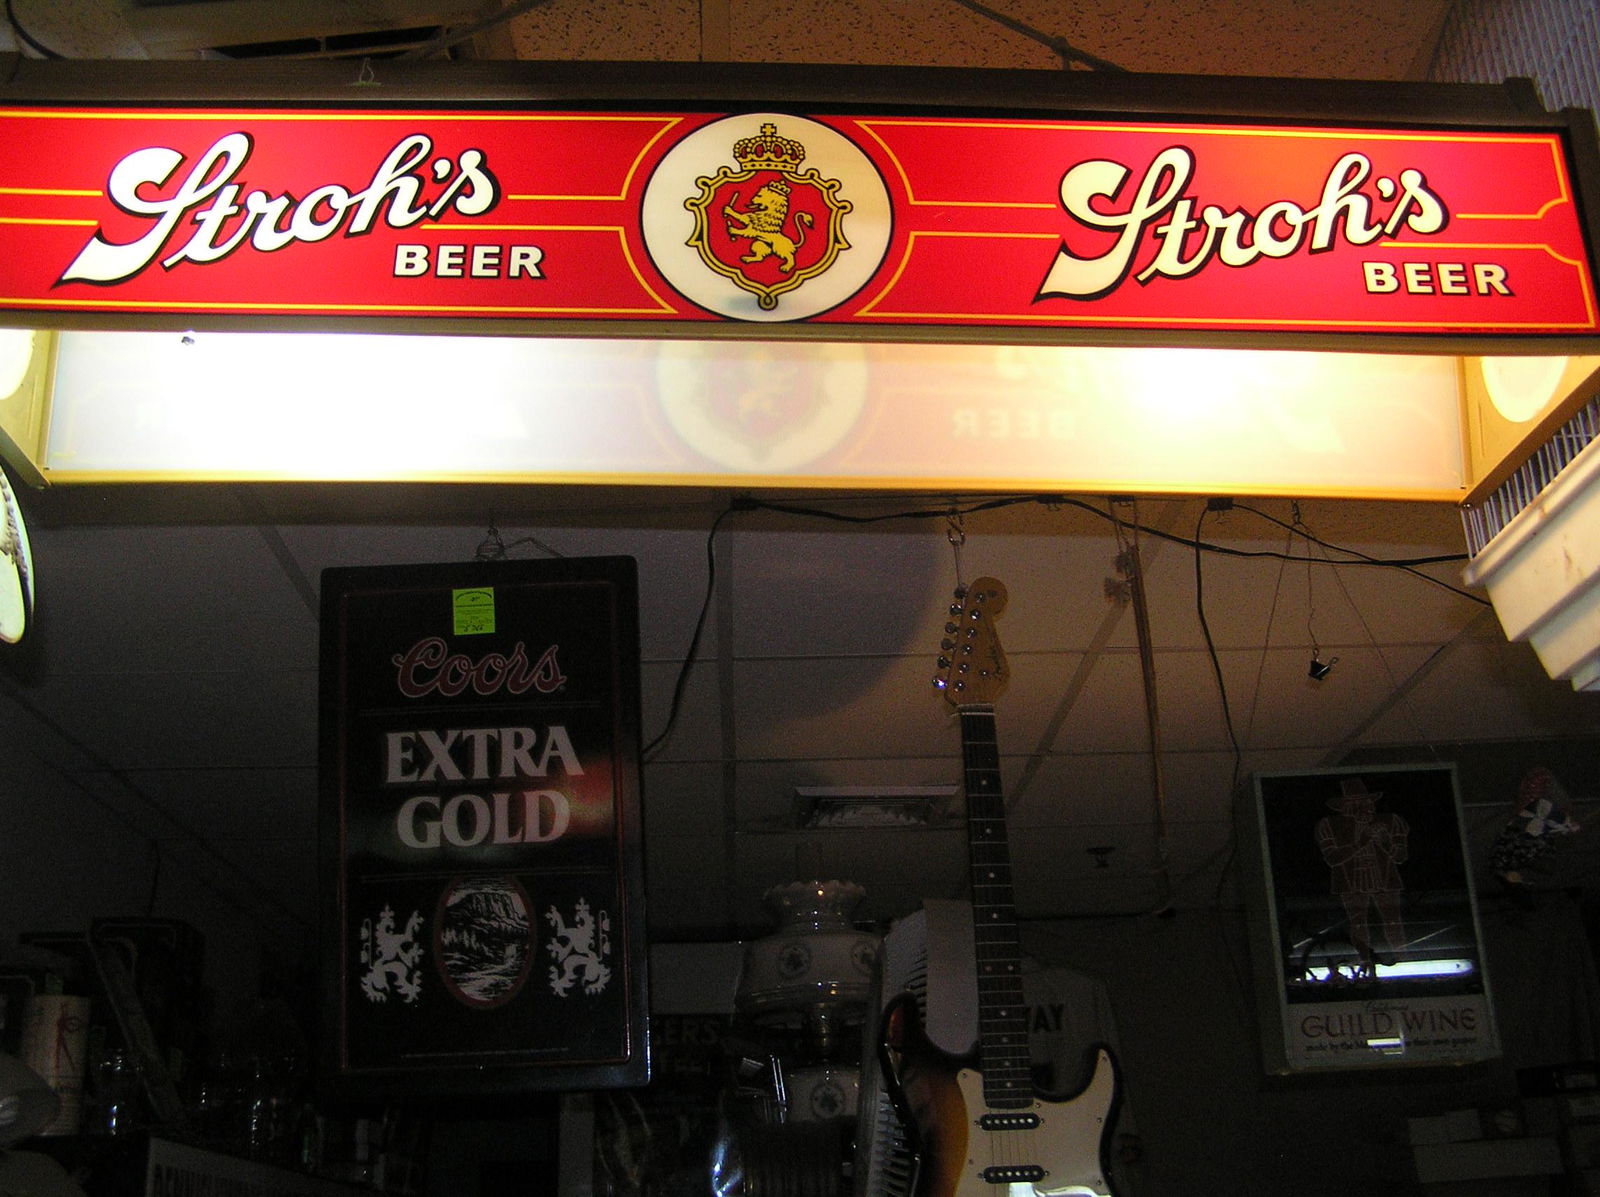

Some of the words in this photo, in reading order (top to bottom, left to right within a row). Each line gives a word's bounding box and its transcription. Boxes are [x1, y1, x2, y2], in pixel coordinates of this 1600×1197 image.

[56, 132, 500, 287] Stroh's
[1033, 144, 1449, 304] Stroh's
[393, 244, 546, 280] BEER
[1363, 260, 1515, 297] BEER
[391, 636, 568, 698] Coors
[385, 725, 585, 784] EXTRA
[397, 789, 571, 849] GOLD
[1301, 1012, 1394, 1038] GUILD
[1401, 1008, 1477, 1033] WINE
